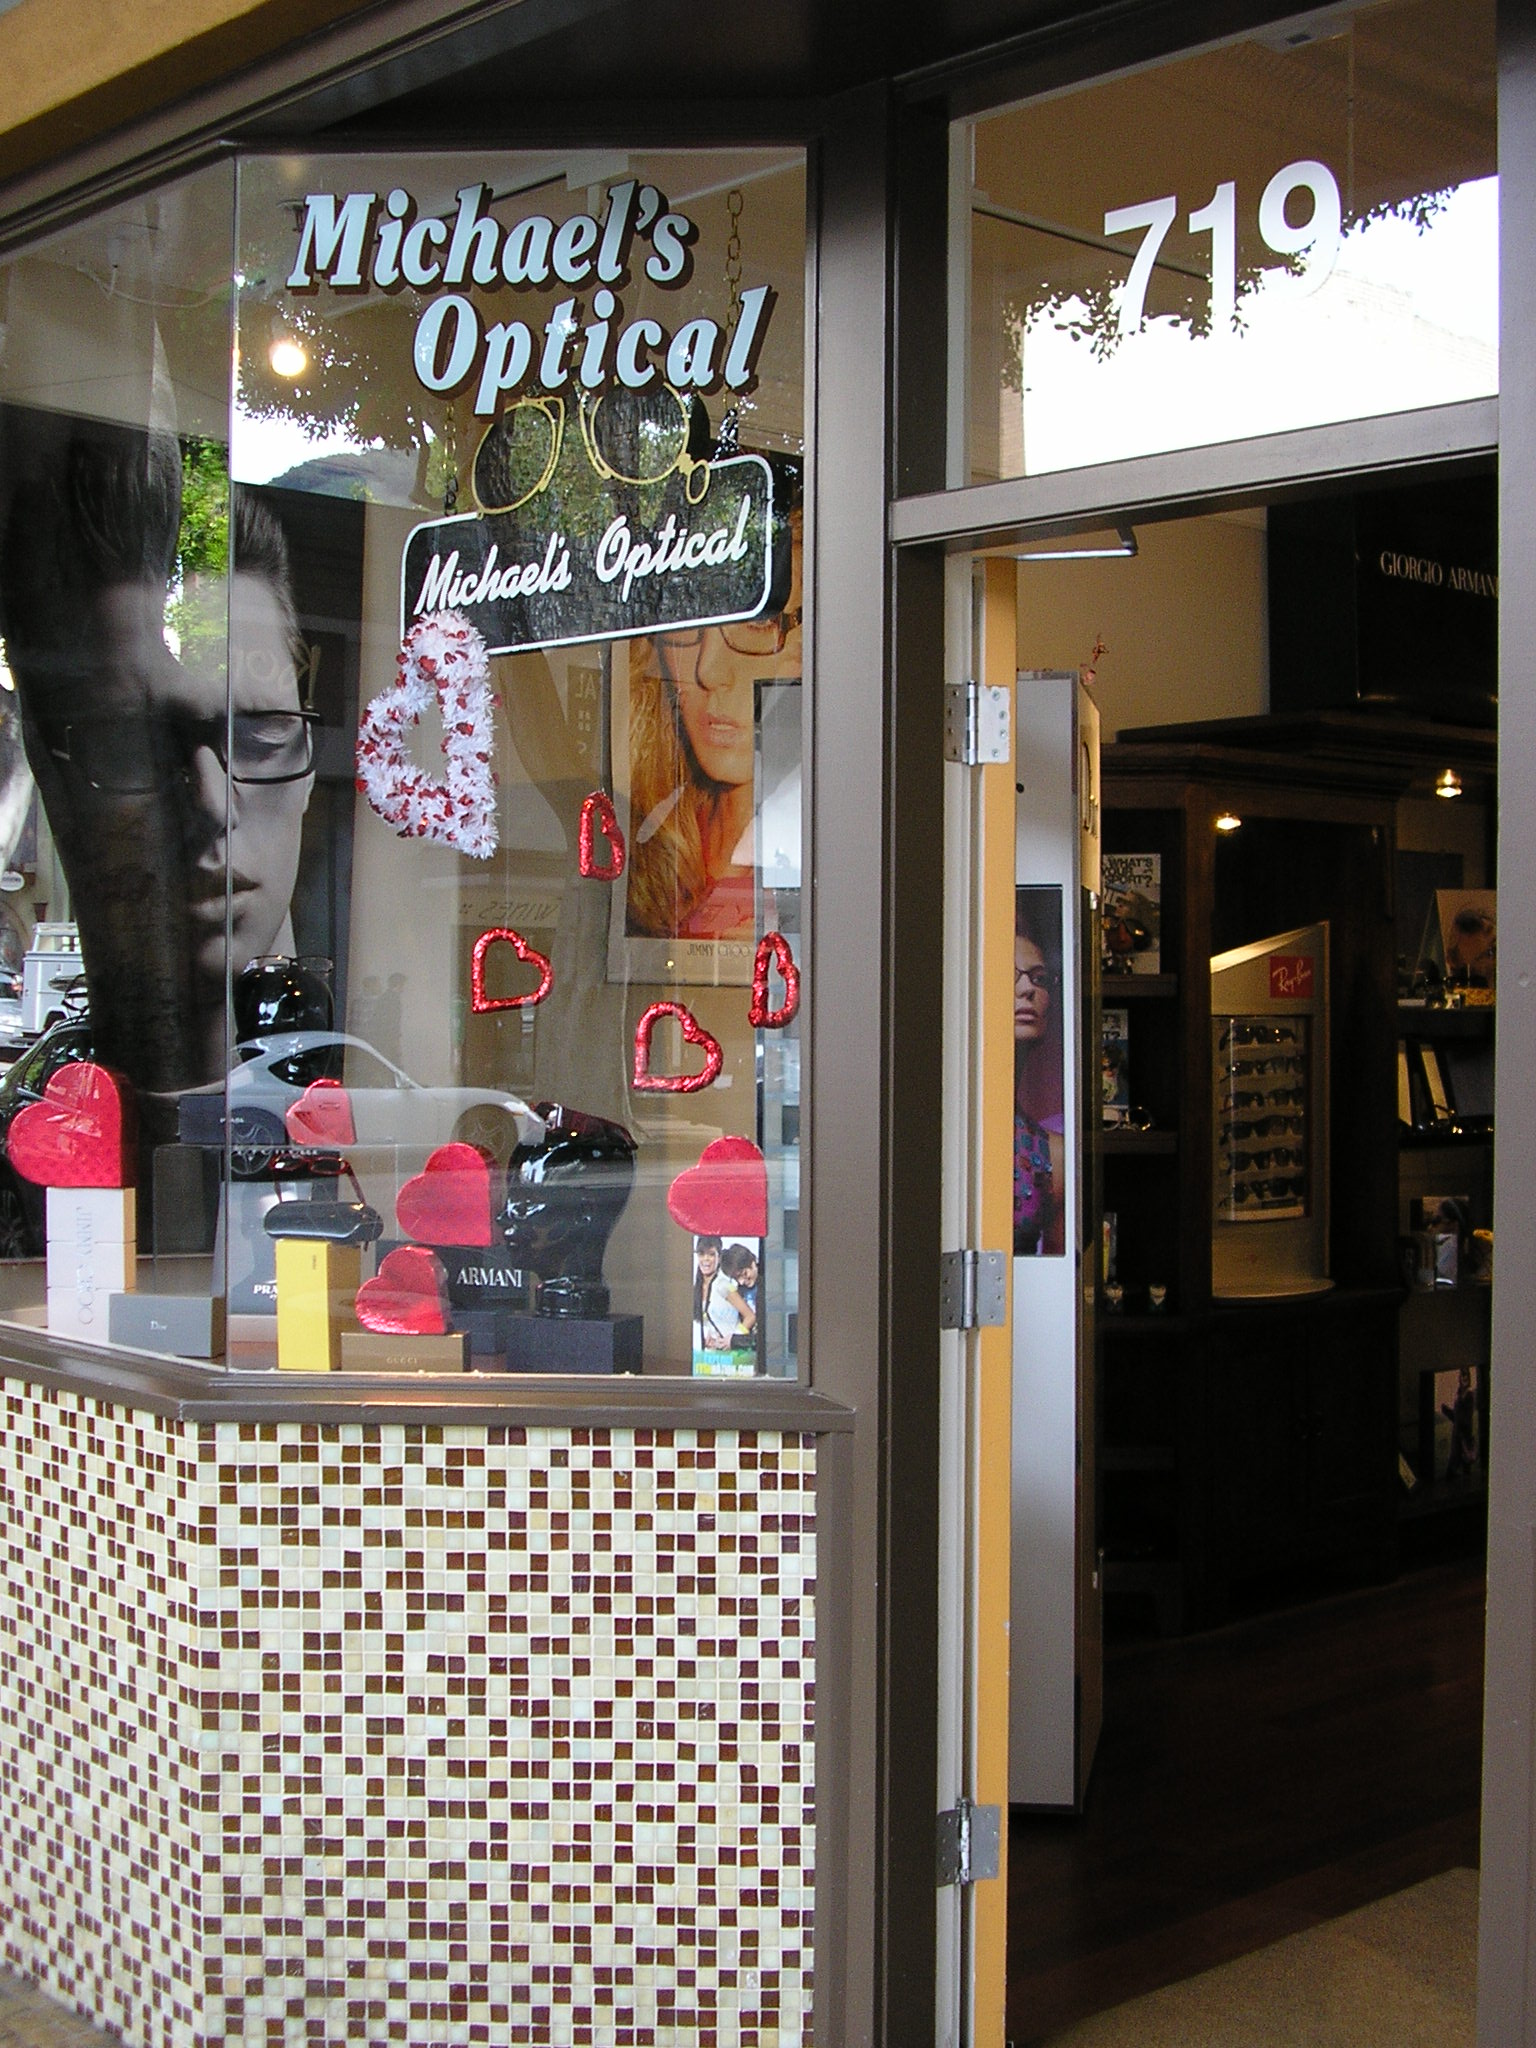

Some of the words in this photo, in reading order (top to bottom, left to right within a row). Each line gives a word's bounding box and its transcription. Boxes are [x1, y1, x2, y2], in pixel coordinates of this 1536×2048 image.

[286, 179, 696, 291] Michael's
[1104, 160, 1342, 334] 719
[413, 285, 773, 415] Optical
[413, 531, 570, 615] Michael's
[595, 495, 750, 602] Optical
[1380, 550, 1443, 586] GIORGIO
[687, 943, 714, 957] JIMMY
[717, 943, 751, 958] CHOO
[456, 1266, 522, 1288] ARMANI
